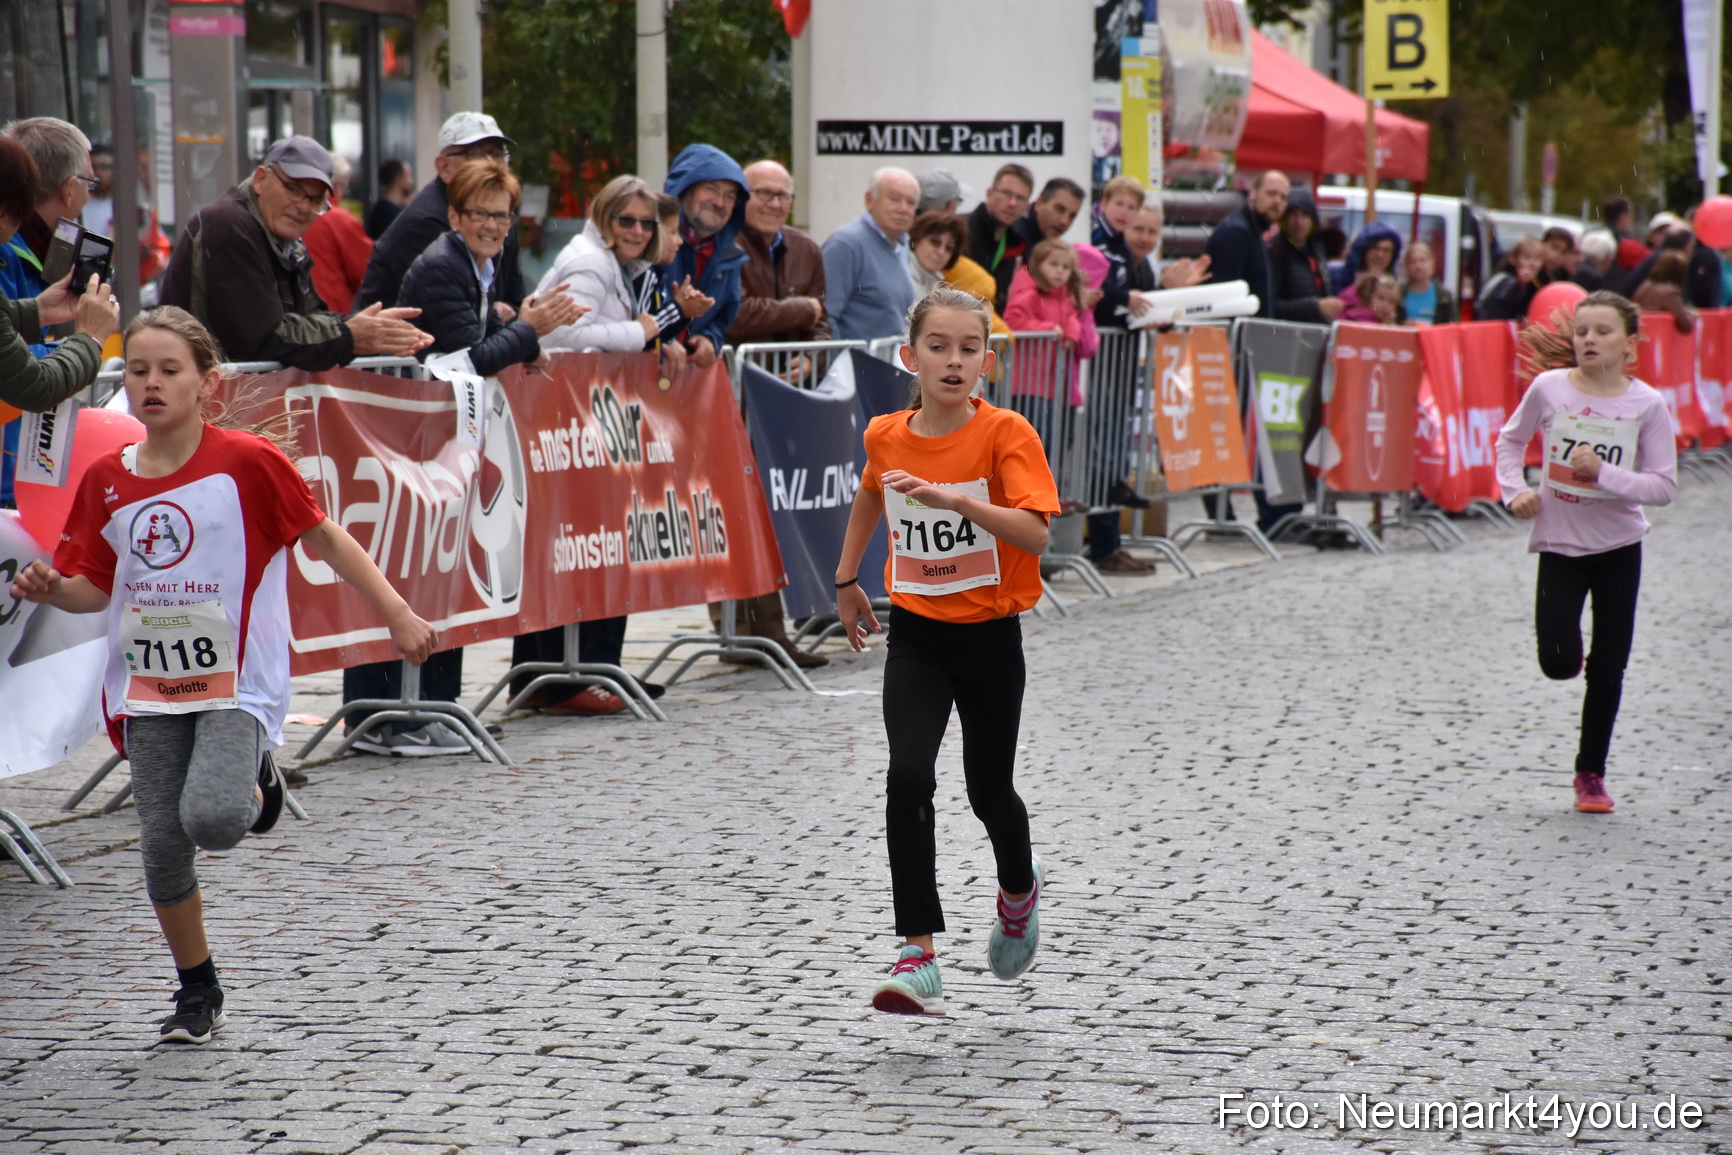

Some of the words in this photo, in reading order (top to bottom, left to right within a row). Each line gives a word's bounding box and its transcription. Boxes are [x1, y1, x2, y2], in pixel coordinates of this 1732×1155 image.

[1387, 14, 1426, 70] B
[818, 124, 1055, 152] www.MINI-Partl.de
[464, 381, 476, 420] swn
[1562, 437, 1623, 466] 760
[900, 516, 976, 553] 7164
[922, 564, 957, 577] Selma
[156, 583, 179, 593] MIT
[151, 616, 190, 627] BOCK
[133, 636, 218, 673] 7118
